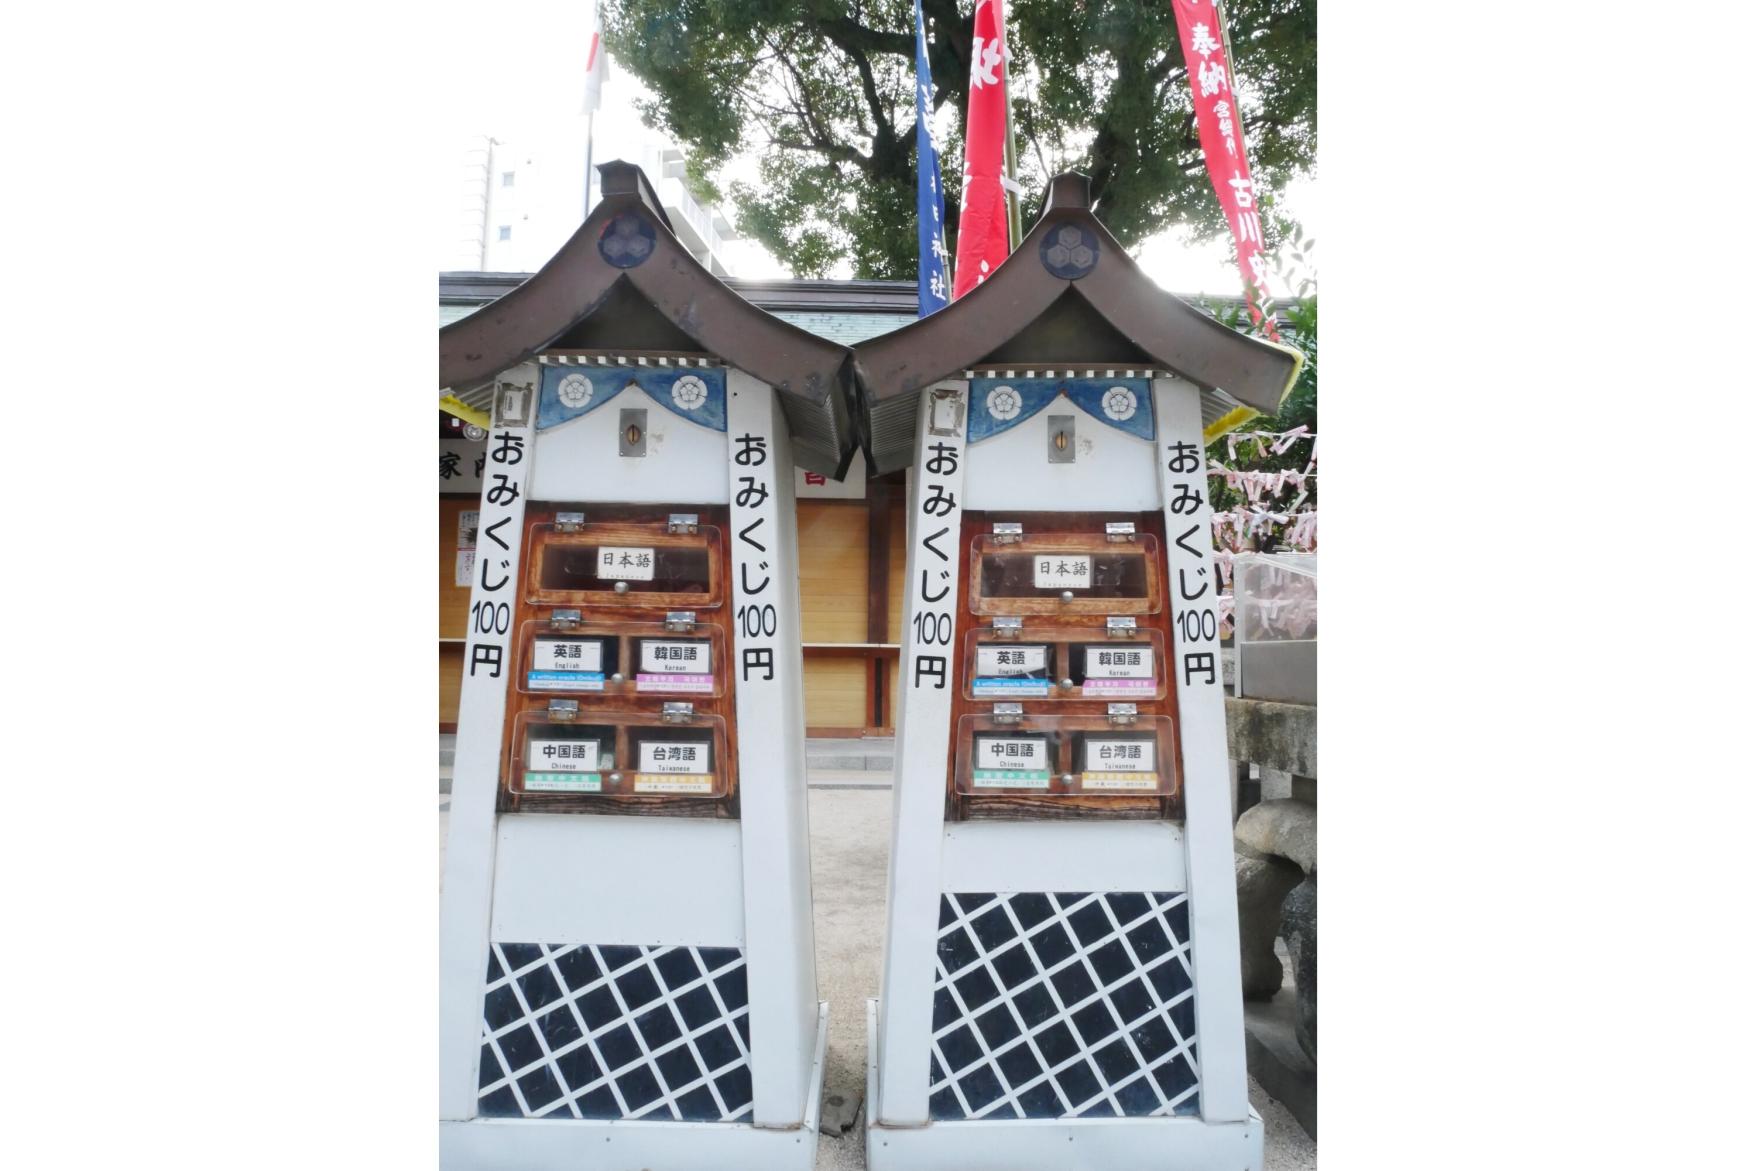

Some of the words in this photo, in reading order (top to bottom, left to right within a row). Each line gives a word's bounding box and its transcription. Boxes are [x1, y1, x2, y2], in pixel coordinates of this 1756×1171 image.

[1192, 22, 1227, 98] 奉納
[471, 431, 524, 678] おみくじ100円
[603, 551, 651, 569] 日本語
[734, 433, 777, 681] おみくじ100円
[913, 442, 958, 688] おみくじ100円
[1040, 560, 1088, 577] 日本語
[1168, 441, 1216, 686] おみくじ100円
[553, 644, 582, 658] 英語
[654, 646, 697, 660] 韓国語
[997, 651, 1025, 665] 英語
[1099, 652, 1140, 665] 韓国語
[543, 744, 585, 758] 中国語
[653, 746, 696, 760] 台湾語
[991, 743, 1034, 757] 中国語
[1100, 745, 1141, 759] 台湾語
